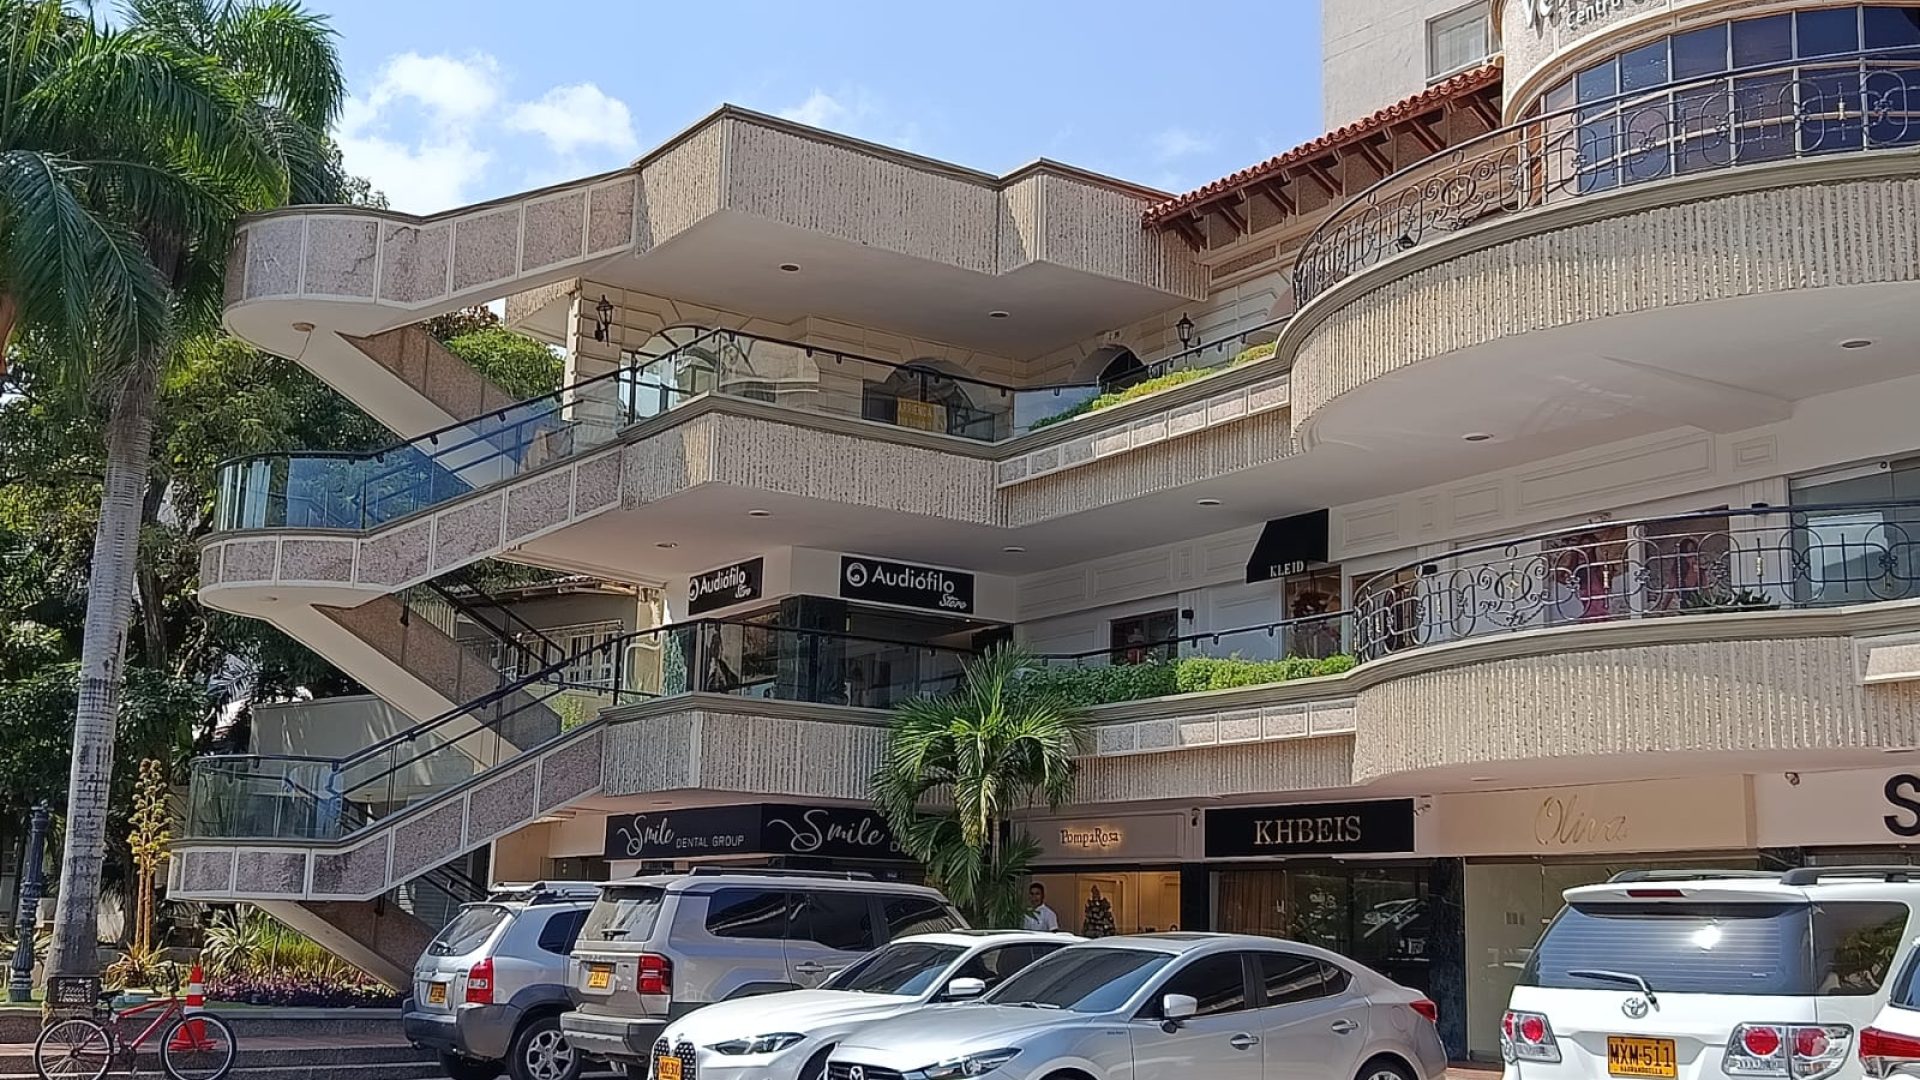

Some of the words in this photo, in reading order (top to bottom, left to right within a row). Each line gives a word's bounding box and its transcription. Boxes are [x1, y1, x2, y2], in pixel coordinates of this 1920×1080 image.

[700, 565, 746, 595] Audiófilo
[871, 564, 955, 593] Audiófilo
[1270, 560, 1304, 578] KLEID
[767, 809, 885, 852] Smile
[1254, 815, 1361, 845] KHBEIS
[1535, 794, 1628, 845] Oliva
[616, 815, 675, 856] Smile
[676, 836, 709, 849] DENTAL
[712, 834, 745, 847] GROUP
[1060, 827, 1119, 848] PompaRosa
